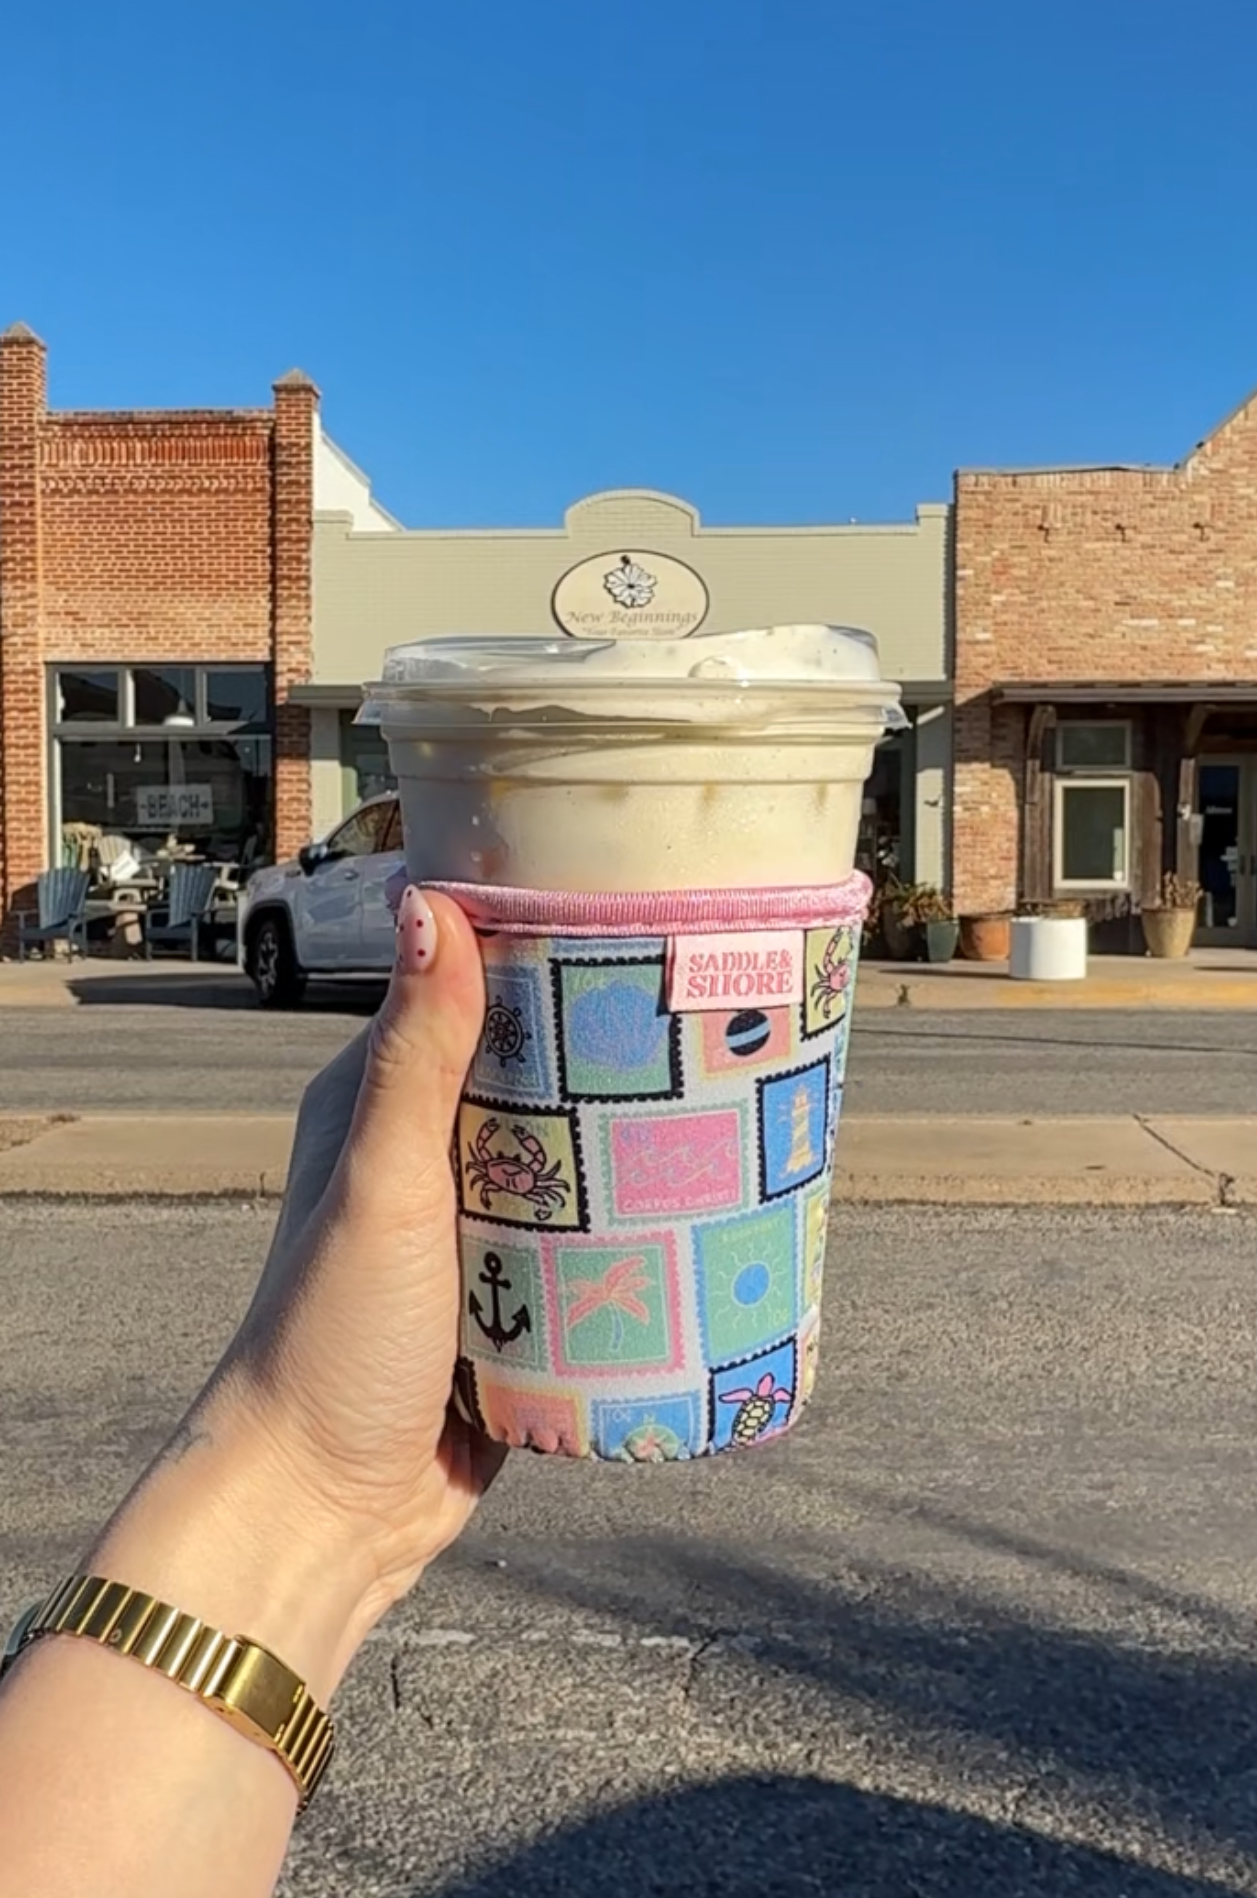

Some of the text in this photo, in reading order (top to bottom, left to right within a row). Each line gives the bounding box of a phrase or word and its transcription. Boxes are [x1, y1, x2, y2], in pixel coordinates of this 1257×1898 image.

[565, 610, 697, 630] New Beginnings
[687, 970, 794, 998] SHORE
